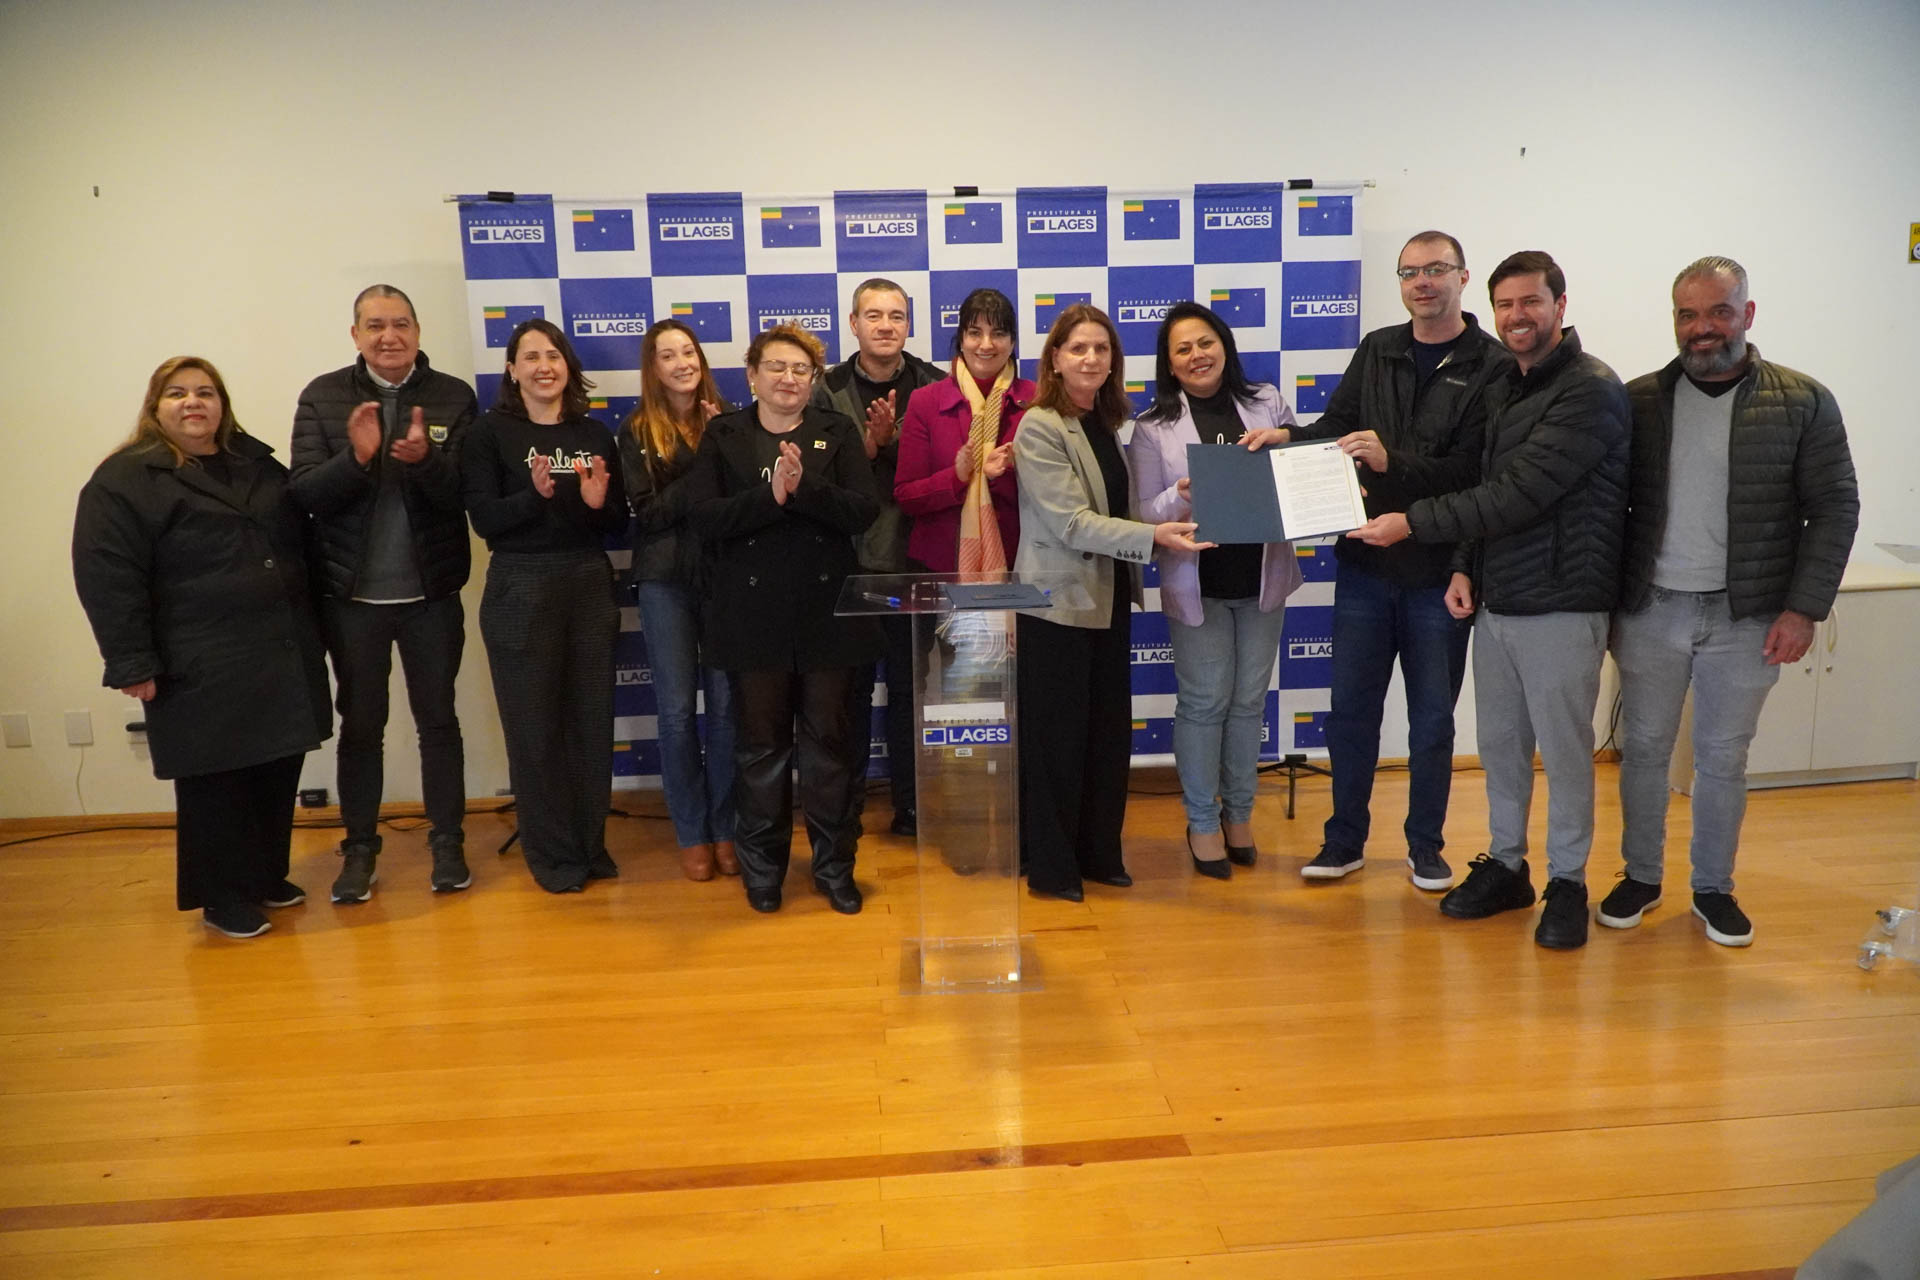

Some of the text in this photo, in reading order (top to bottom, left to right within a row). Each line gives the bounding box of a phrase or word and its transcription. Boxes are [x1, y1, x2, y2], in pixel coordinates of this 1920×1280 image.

[1048, 218, 1094, 230] LAGES
[1225, 214, 1269, 226] LAGES
[493, 228, 542, 240] LAGES
[682, 226, 730, 238] LAGES
[868, 222, 914, 234] LAGES
[1139, 308, 1168, 320] LAG
[1311, 303, 1355, 314] LAGES
[596, 322, 643, 333] LAGES
[781, 317, 828, 329] GES
[1141, 651, 1174, 661] LAGE
[621, 671, 652, 682] LAG
[949, 728, 1008, 743] LAGES
